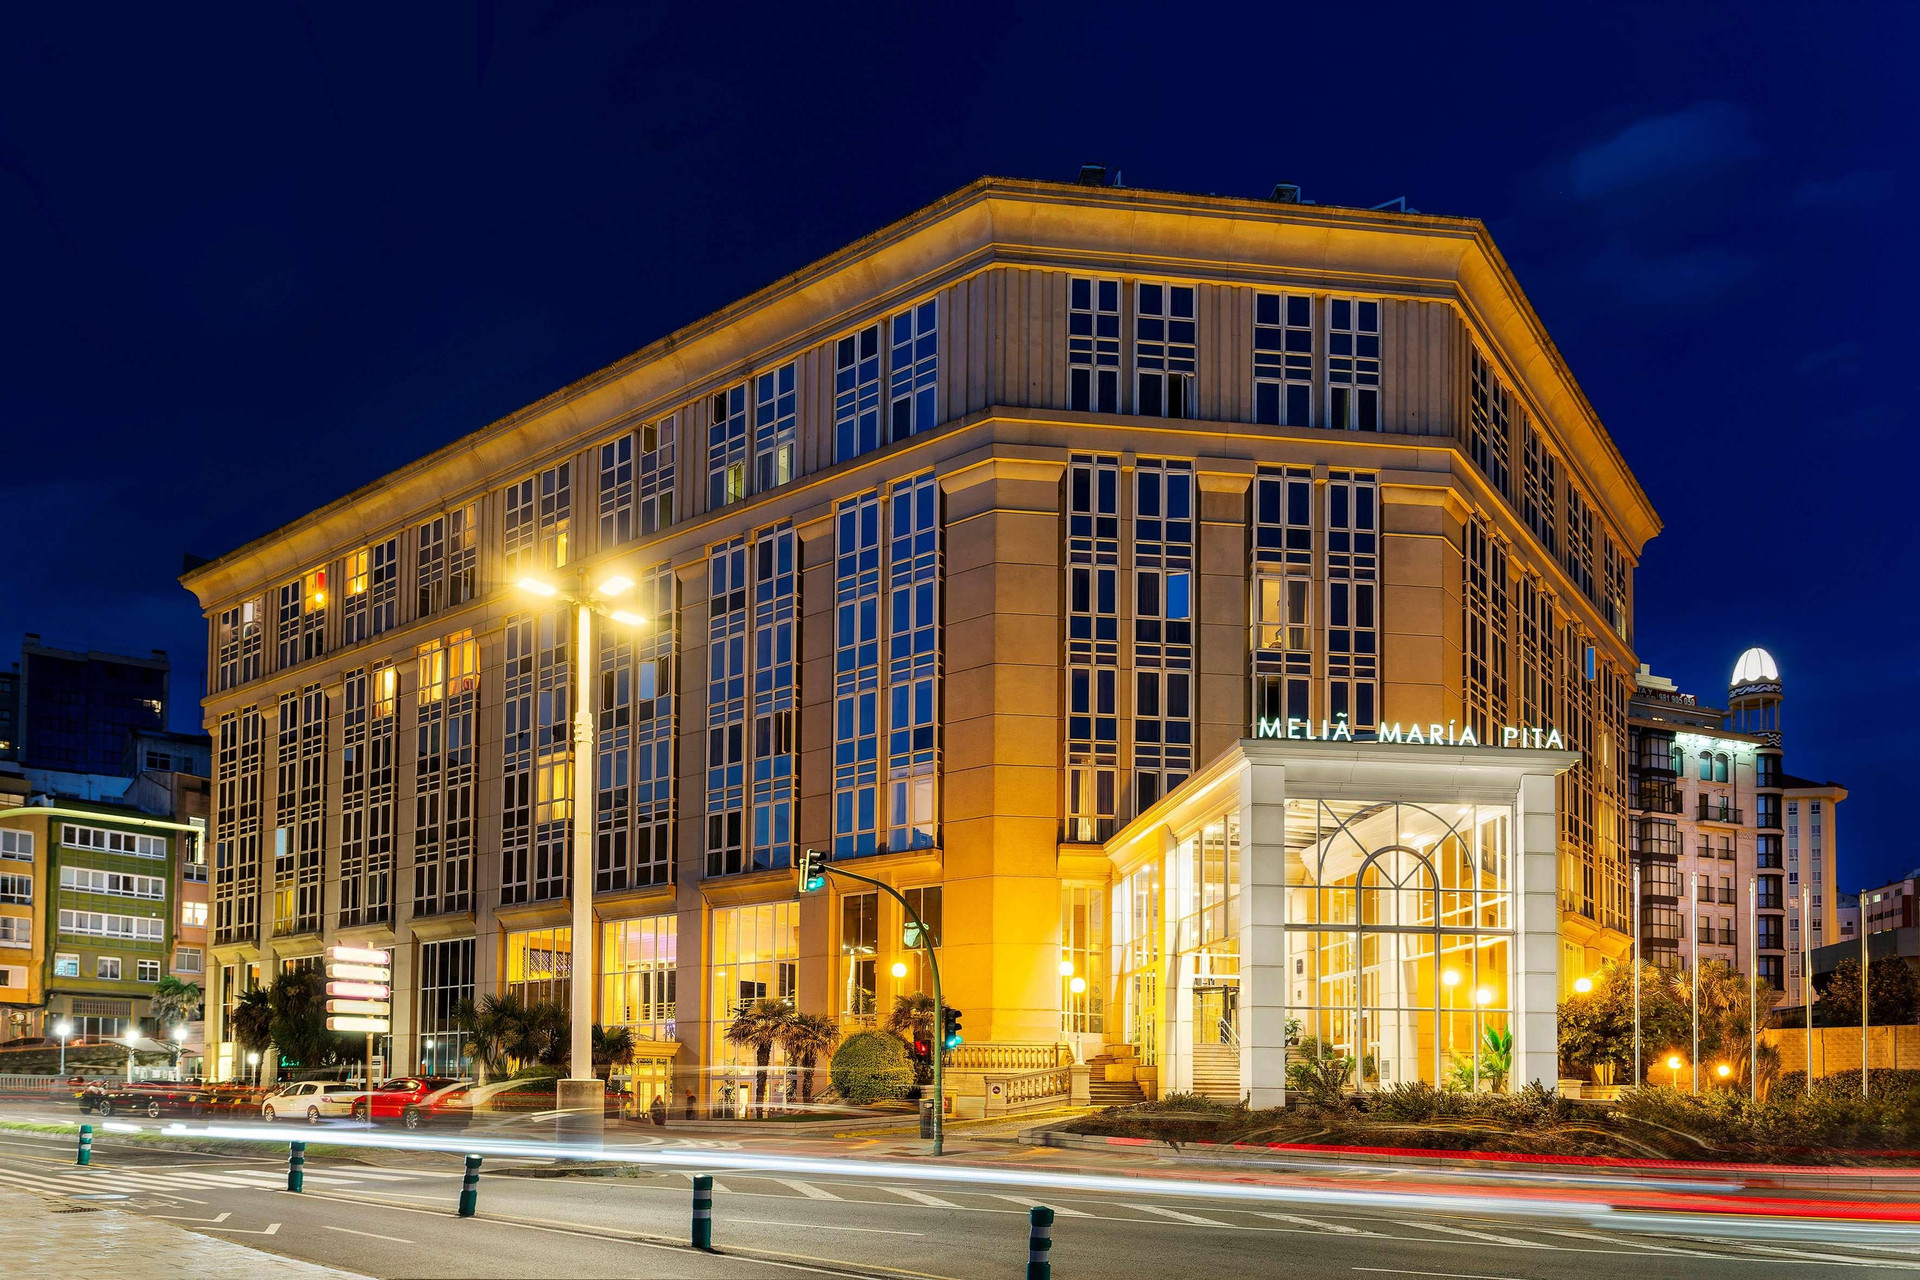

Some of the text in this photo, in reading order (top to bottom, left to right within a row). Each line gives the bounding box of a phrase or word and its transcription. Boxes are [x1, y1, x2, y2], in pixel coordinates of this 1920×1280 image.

[1658, 693, 1670, 702] 981
[1671, 695, 1683, 705] 905
[1683, 697, 1695, 706] 050
[1378, 719, 1478, 746] MARÍA
[1503, 727, 1564, 750] PITA
